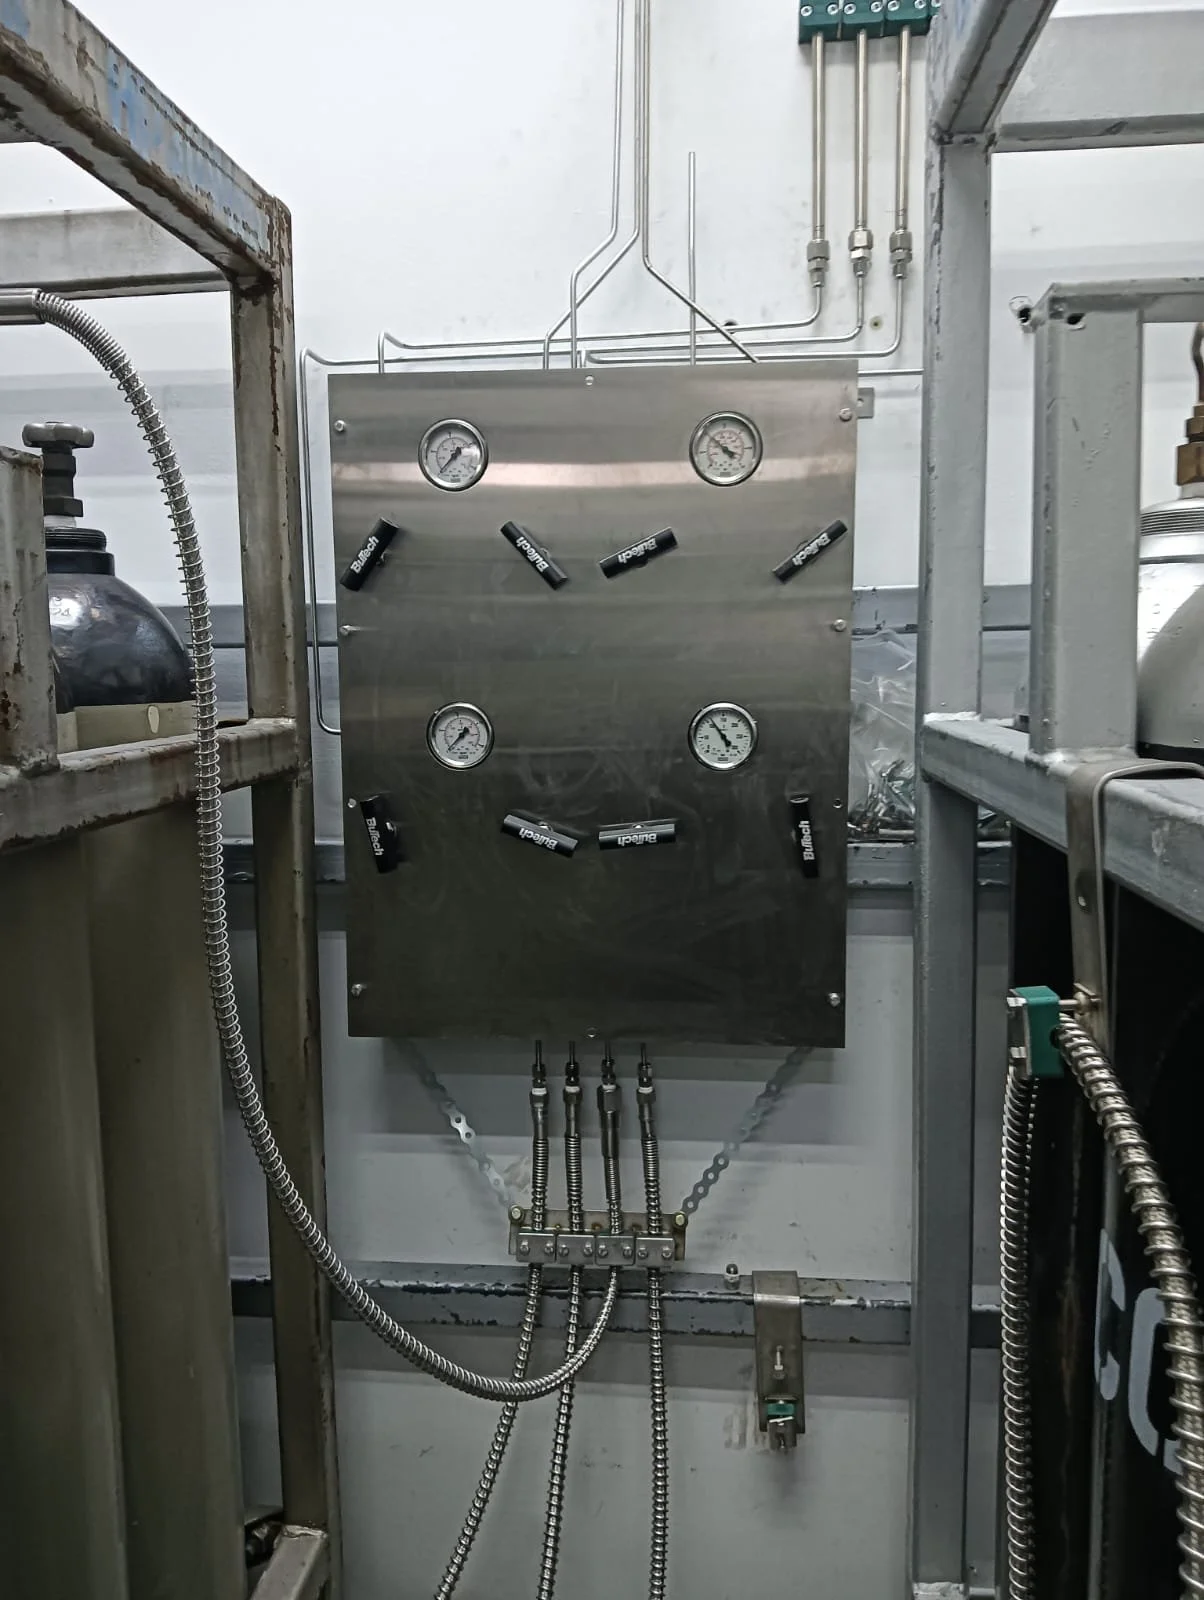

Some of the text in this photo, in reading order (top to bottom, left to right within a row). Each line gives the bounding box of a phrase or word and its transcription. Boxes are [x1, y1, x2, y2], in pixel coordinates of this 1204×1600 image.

[350, 535, 379, 573] BuTech
[515, 536, 550, 572] BuTech
[618, 538, 657, 563] BuTech
[792, 533, 831, 566] BuTech
[365, 816, 384, 856] BuTech
[518, 827, 558, 850] BuTech
[618, 833, 657, 846] BuTech
[799, 820, 815, 861] BuTech
